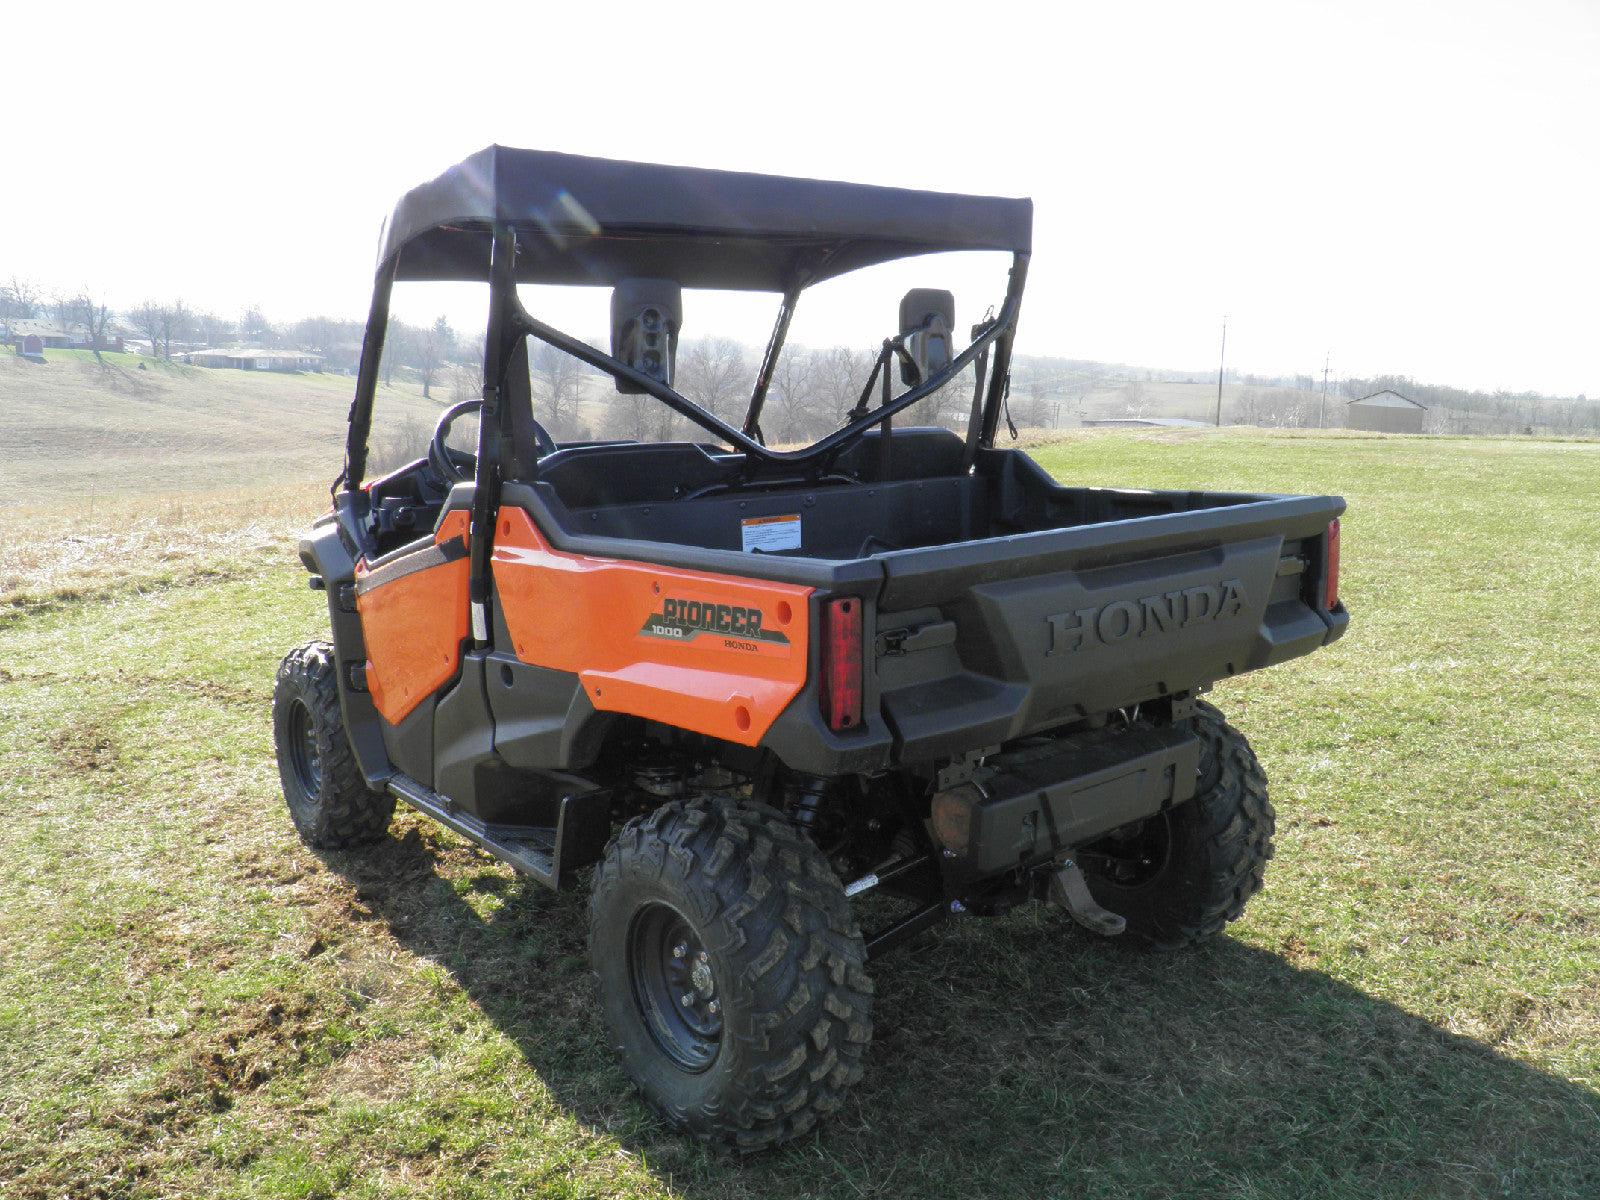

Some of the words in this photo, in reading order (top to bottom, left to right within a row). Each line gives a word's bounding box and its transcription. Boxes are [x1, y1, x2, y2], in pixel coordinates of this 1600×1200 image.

[663, 598, 763, 638] PIONEER
[1044, 578, 1250, 656] HONDA
[652, 624, 683, 638] 1000
[724, 639, 759, 652] HONDA
